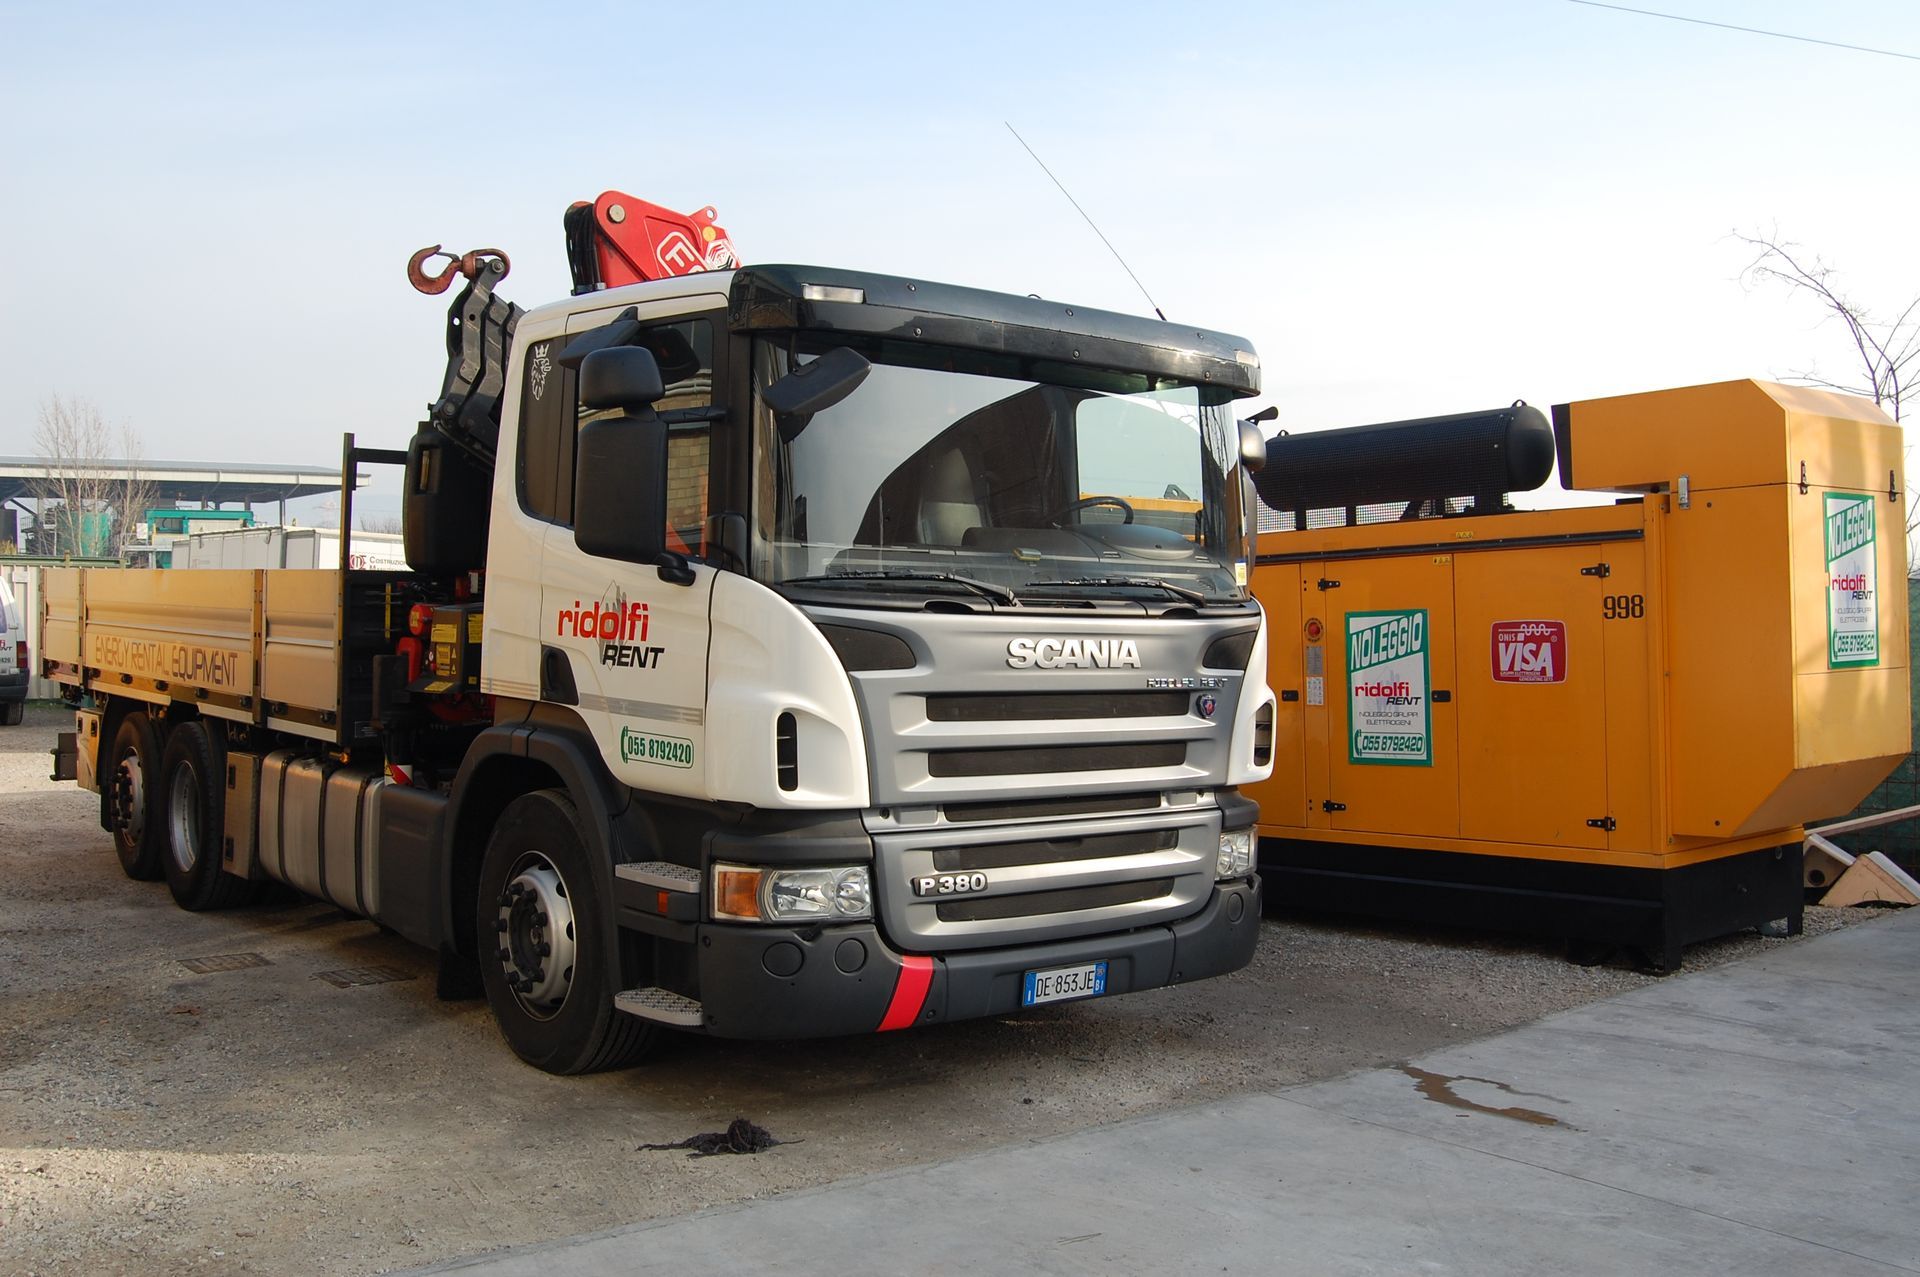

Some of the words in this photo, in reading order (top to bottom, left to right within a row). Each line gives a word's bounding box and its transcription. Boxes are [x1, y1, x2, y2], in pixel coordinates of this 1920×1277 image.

[1829, 499, 1872, 560] NOLEGGIO
[1832, 575, 1866, 591] ridolfi
[1852, 591, 1873, 600] RENT
[1603, 594, 1644, 620] 998
[557, 600, 649, 641] ridolfi
[1351, 612, 1423, 671] NOLEGGIO
[1498, 632, 1516, 641] ONIS
[95, 636, 129, 668] ENERGY
[131, 641, 170, 675] RENTAL
[172, 645, 238, 687] EQUIPMENT
[602, 644, 665, 669] RENT
[1005, 638, 1141, 669] SCANIA
[1498, 642, 1553, 677] VISA
[1146, 678, 1194, 688] RIDOLFI
[1200, 678, 1228, 688] RENT
[1355, 682, 1410, 697] ridolfi
[1386, 697, 1421, 706] RENT
[627, 735, 646, 756] 055
[648, 738, 692, 764] 8792420
[1362, 735, 1380, 751] 055
[1381, 735, 1423, 752] 8792420
